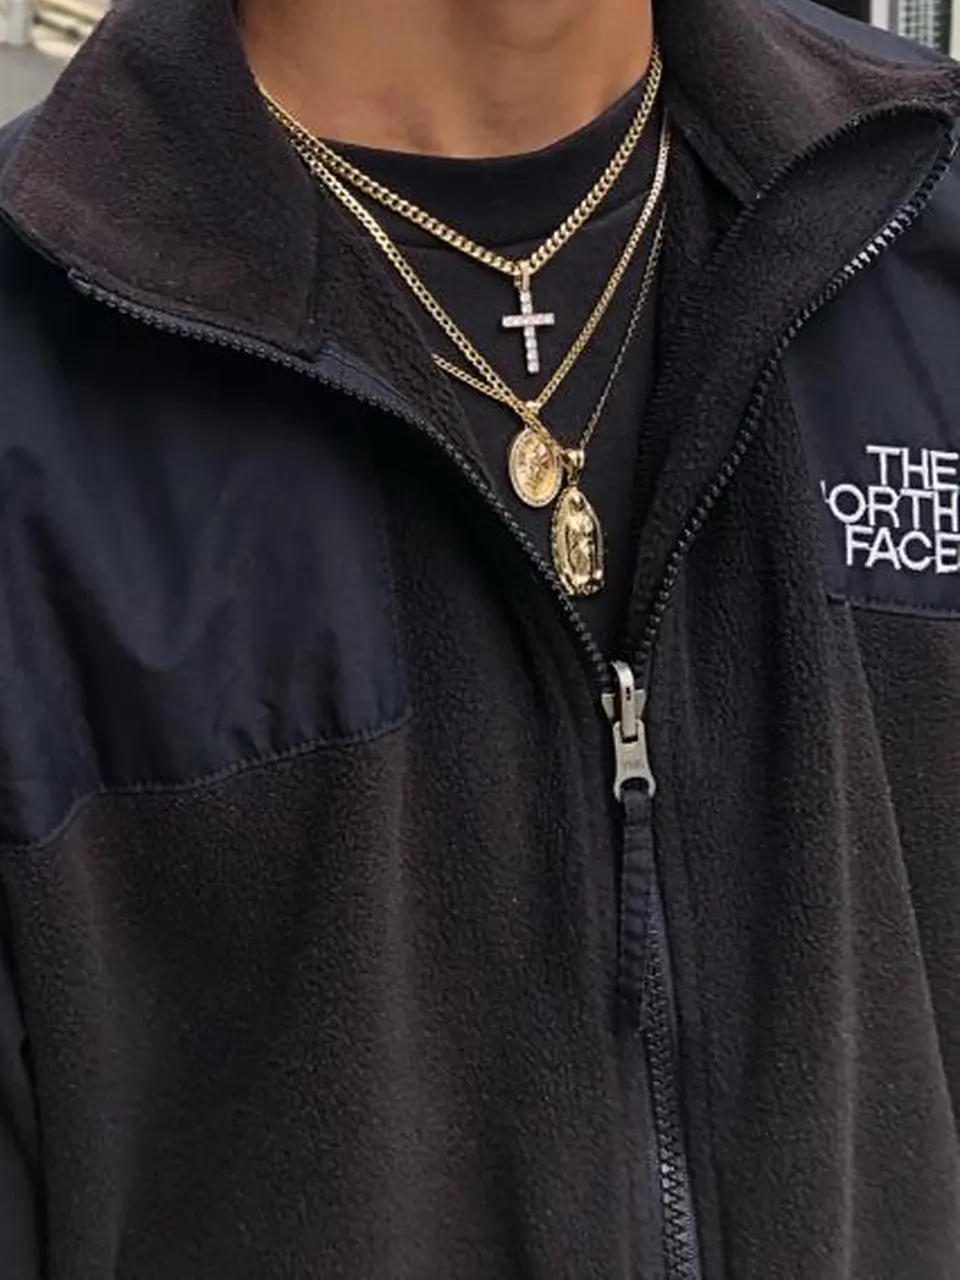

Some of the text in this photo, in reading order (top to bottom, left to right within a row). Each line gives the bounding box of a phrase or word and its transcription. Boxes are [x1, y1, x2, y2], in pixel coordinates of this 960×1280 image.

[866, 444, 959, 490] THE
[820, 480, 959, 532] ORTH
[846, 524, 960, 574] FACE
